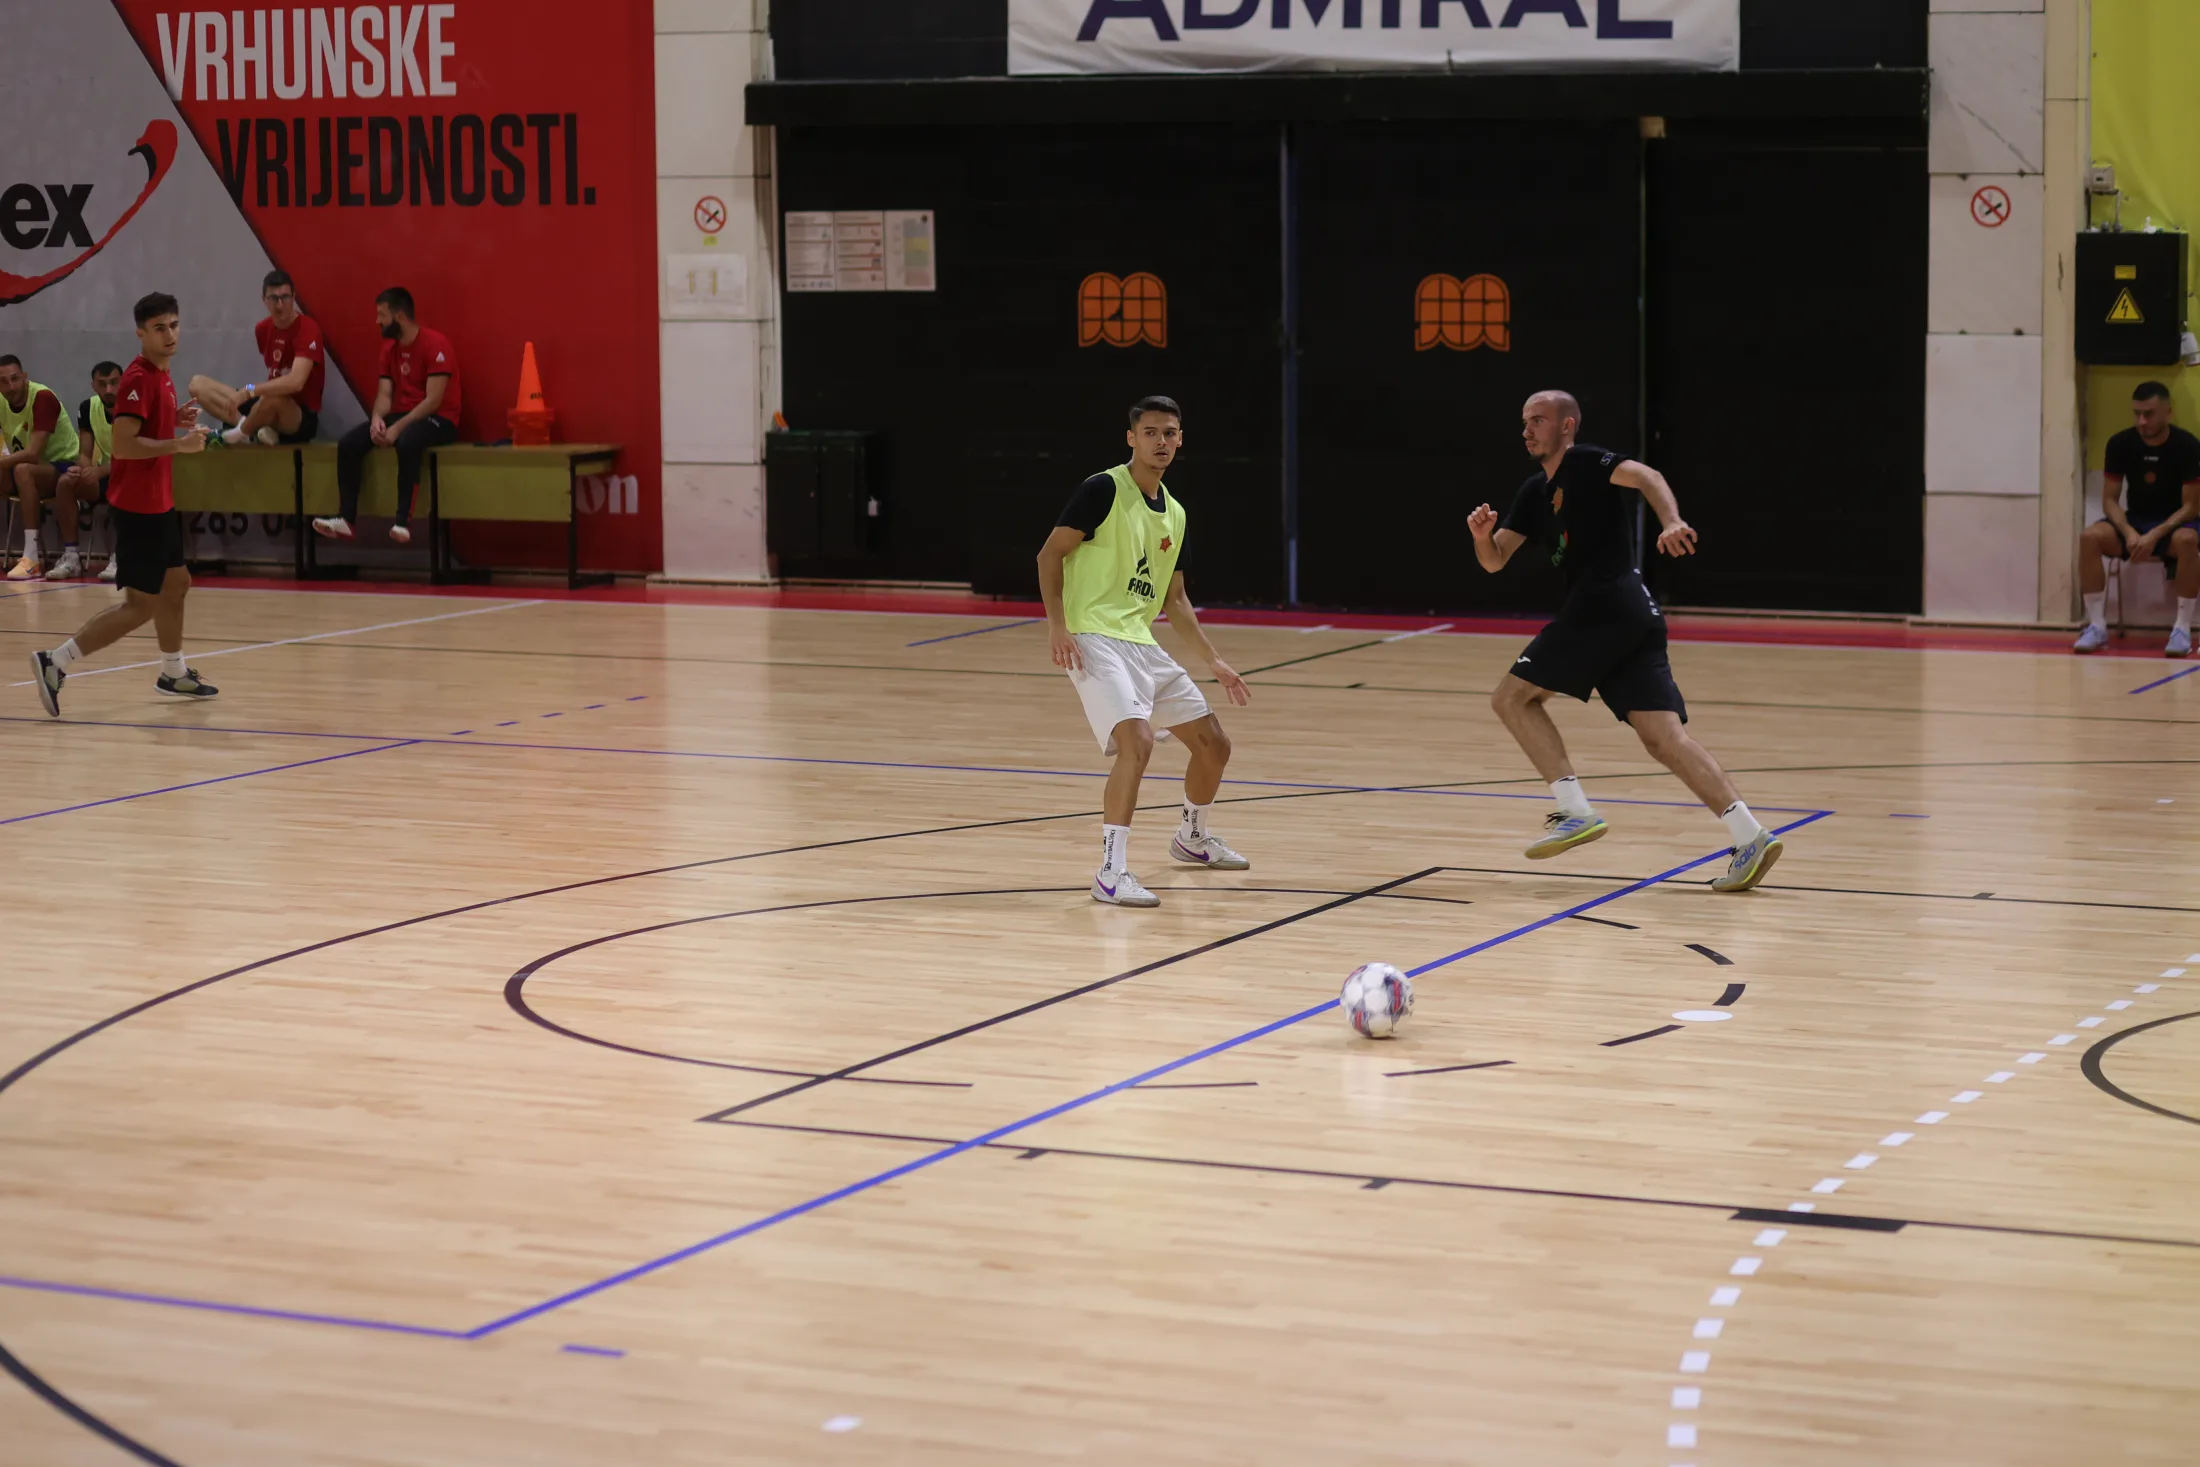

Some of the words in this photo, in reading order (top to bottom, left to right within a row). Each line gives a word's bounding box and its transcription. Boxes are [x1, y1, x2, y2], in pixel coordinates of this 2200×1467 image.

[155, 3, 457, 101] VRHUNSKE
[216, 113, 596, 208] VRIJEDNOSTI.
[0, 183, 95, 250] ex
[1735, 843, 1756, 869] sala
